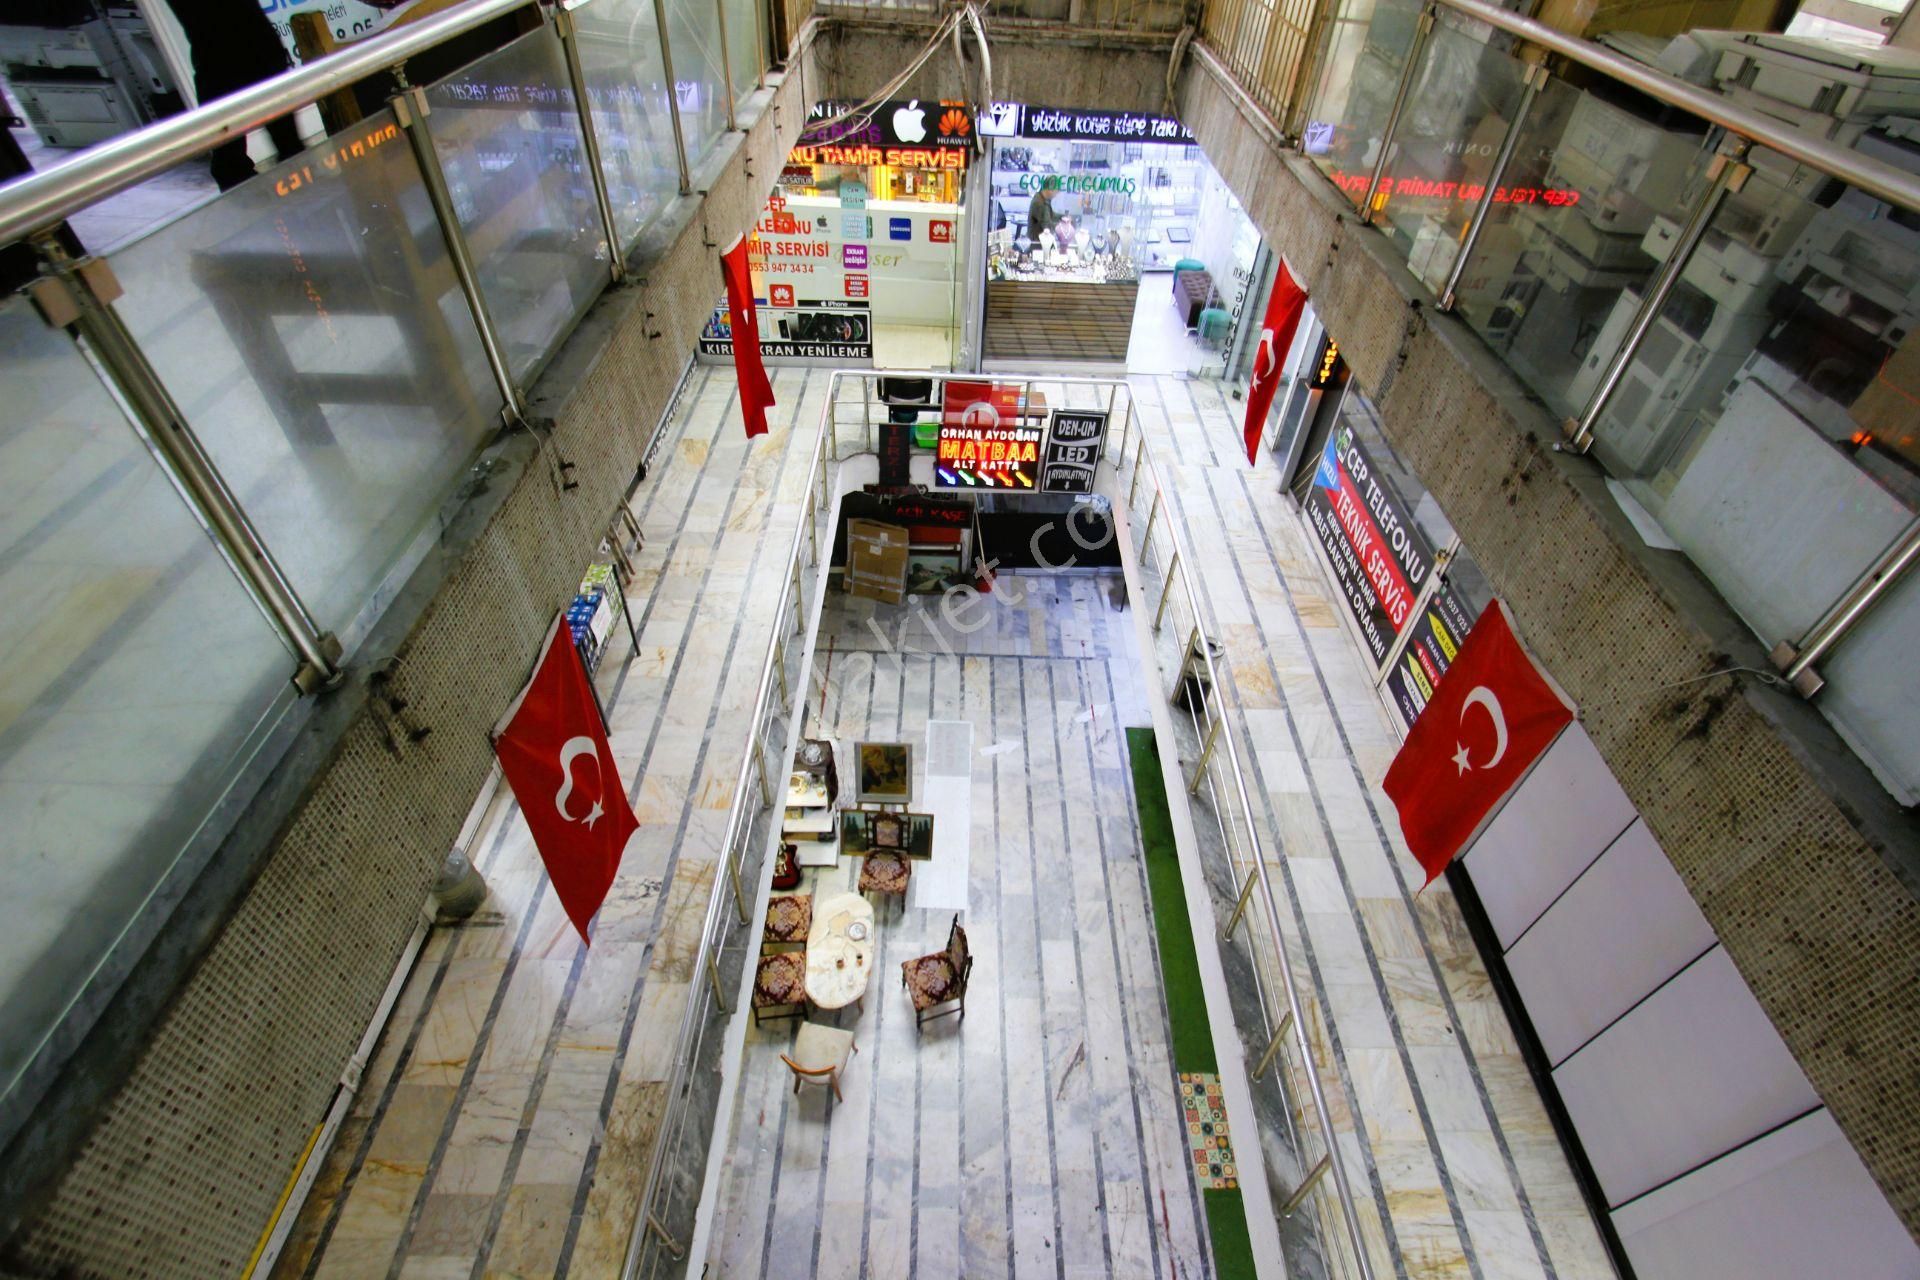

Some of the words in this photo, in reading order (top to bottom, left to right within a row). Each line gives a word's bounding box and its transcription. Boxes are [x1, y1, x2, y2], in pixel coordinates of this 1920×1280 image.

[937, 137, 971, 146] HUAWEI
[819, 144, 883, 165] TAMİR
[886, 147, 966, 168] SERVİSİ
[1081, 173, 1136, 194] GÜMÜŞ
[776, 240, 829, 258] SERVİSİ
[771, 263, 788, 274] 947
[798, 343, 868, 358] YENİLEME
[941, 428, 982, 440] ORHAN
[984, 428, 1040, 442] AYDOĞAN
[940, 440, 1036, 462] MATBAA
[1056, 446, 1090, 463] LED
[952, 459, 977, 470] ALT
[980, 460, 1020, 471] KATTA
[1321, 456, 1338, 487] HIZLI
[1347, 447, 1368, 483] CEP
[1365, 477, 1425, 584] TELEFONU
[1326, 509, 1342, 540] KIRIK
[1339, 535, 1359, 576] EKRAN
[1356, 569, 1377, 611] TAMİR
[1336, 487, 1373, 560] TEKNİK
[1367, 549, 1408, 625] SERVİS
[1310, 499, 1330, 541] TABLET
[1327, 537, 1348, 581] BAKIM
[1345, 577, 1354, 597] ve
[1353, 593, 1386, 659] ONARIMI
